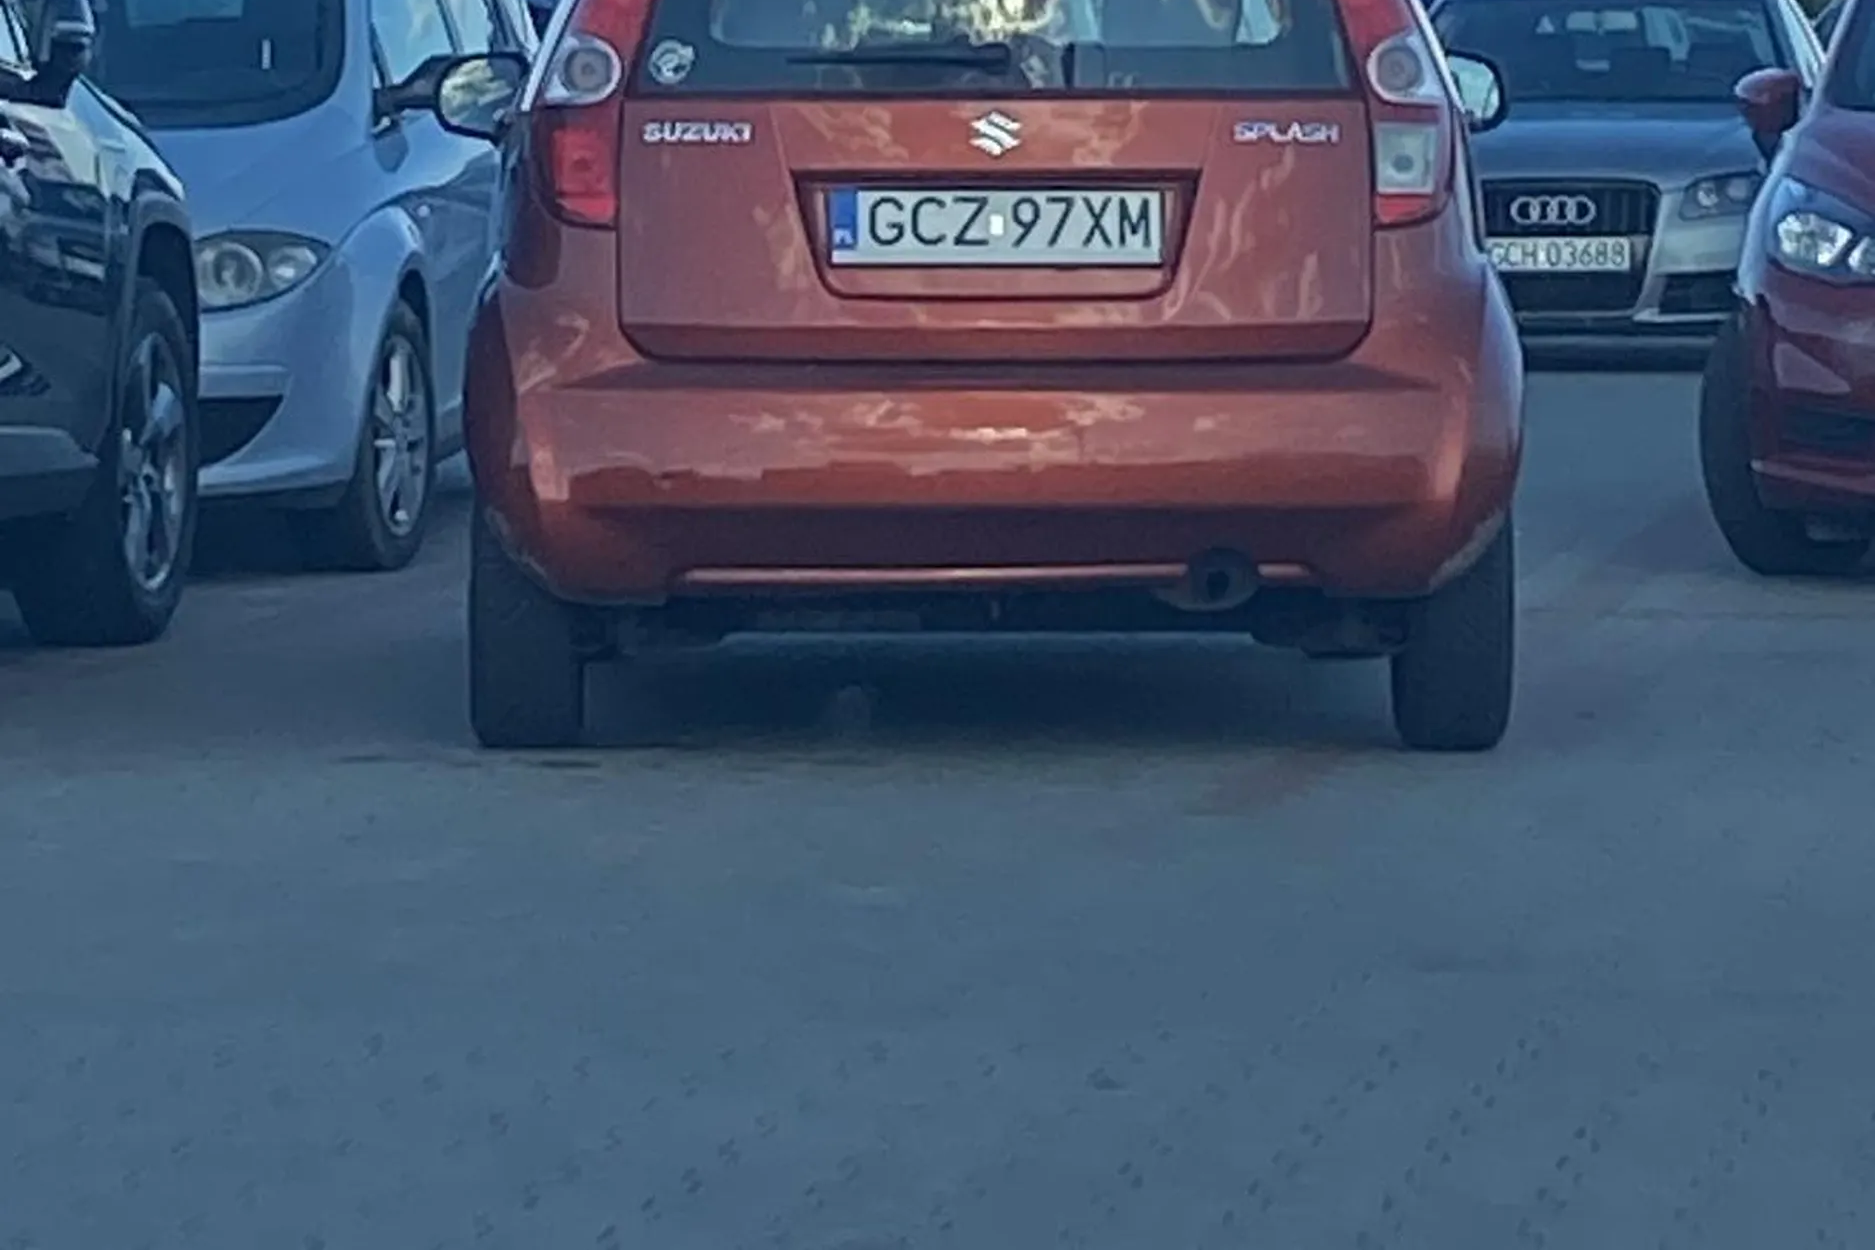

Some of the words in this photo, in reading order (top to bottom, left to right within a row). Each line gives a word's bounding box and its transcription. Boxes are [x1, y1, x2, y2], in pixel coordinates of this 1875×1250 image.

[643, 121, 752, 141] SUZUKI
[1233, 121, 1340, 143] SPLASH
[868, 196, 989, 246] GCZ
[1011, 196, 1152, 248] 97XM
[1546, 240, 1626, 267] 03688
